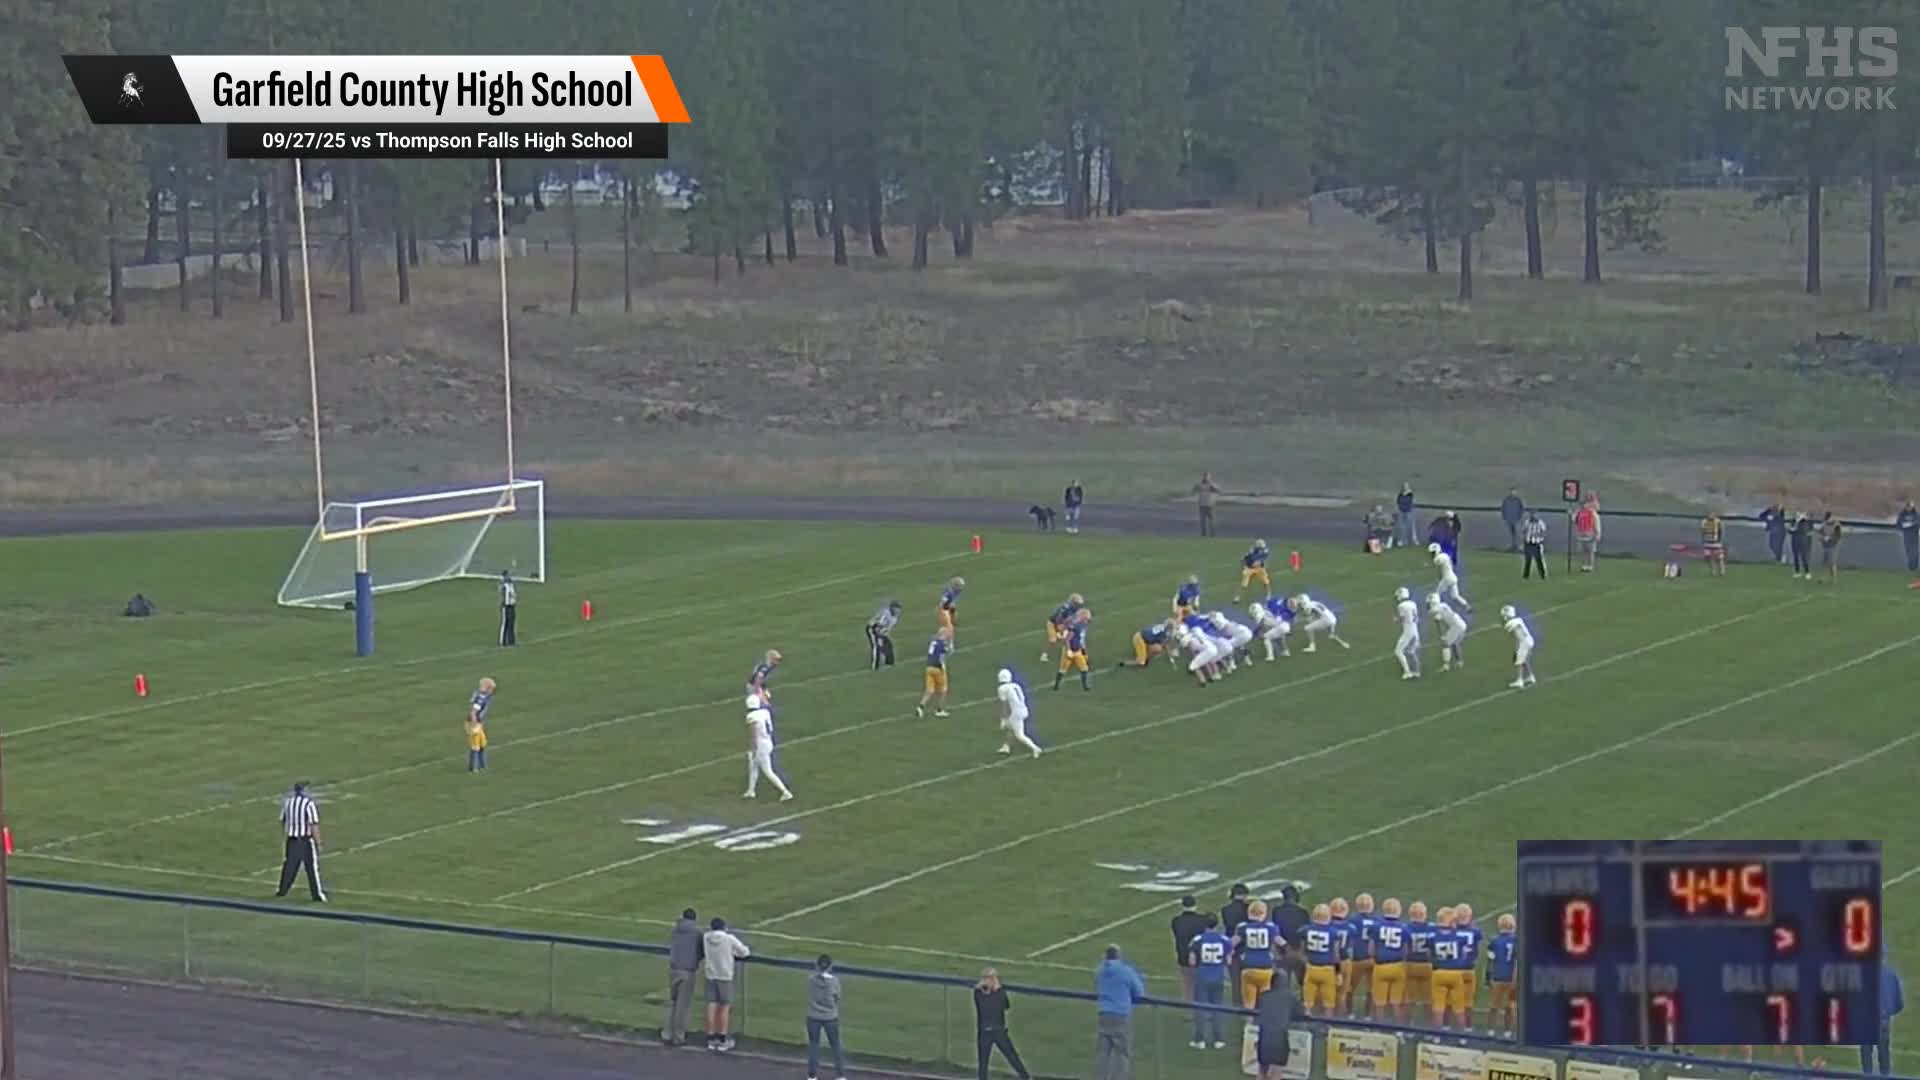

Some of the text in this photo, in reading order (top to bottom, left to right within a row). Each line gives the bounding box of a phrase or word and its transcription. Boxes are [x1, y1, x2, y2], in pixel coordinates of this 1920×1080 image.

[1564, 482, 1578, 499] 3
[1246, 928, 1269, 949] 60
[1307, 930, 1330, 952] 52
[1379, 926, 1402, 948] 45
[1201, 943, 1223, 964] 62
[1435, 941, 1458, 960] 54
